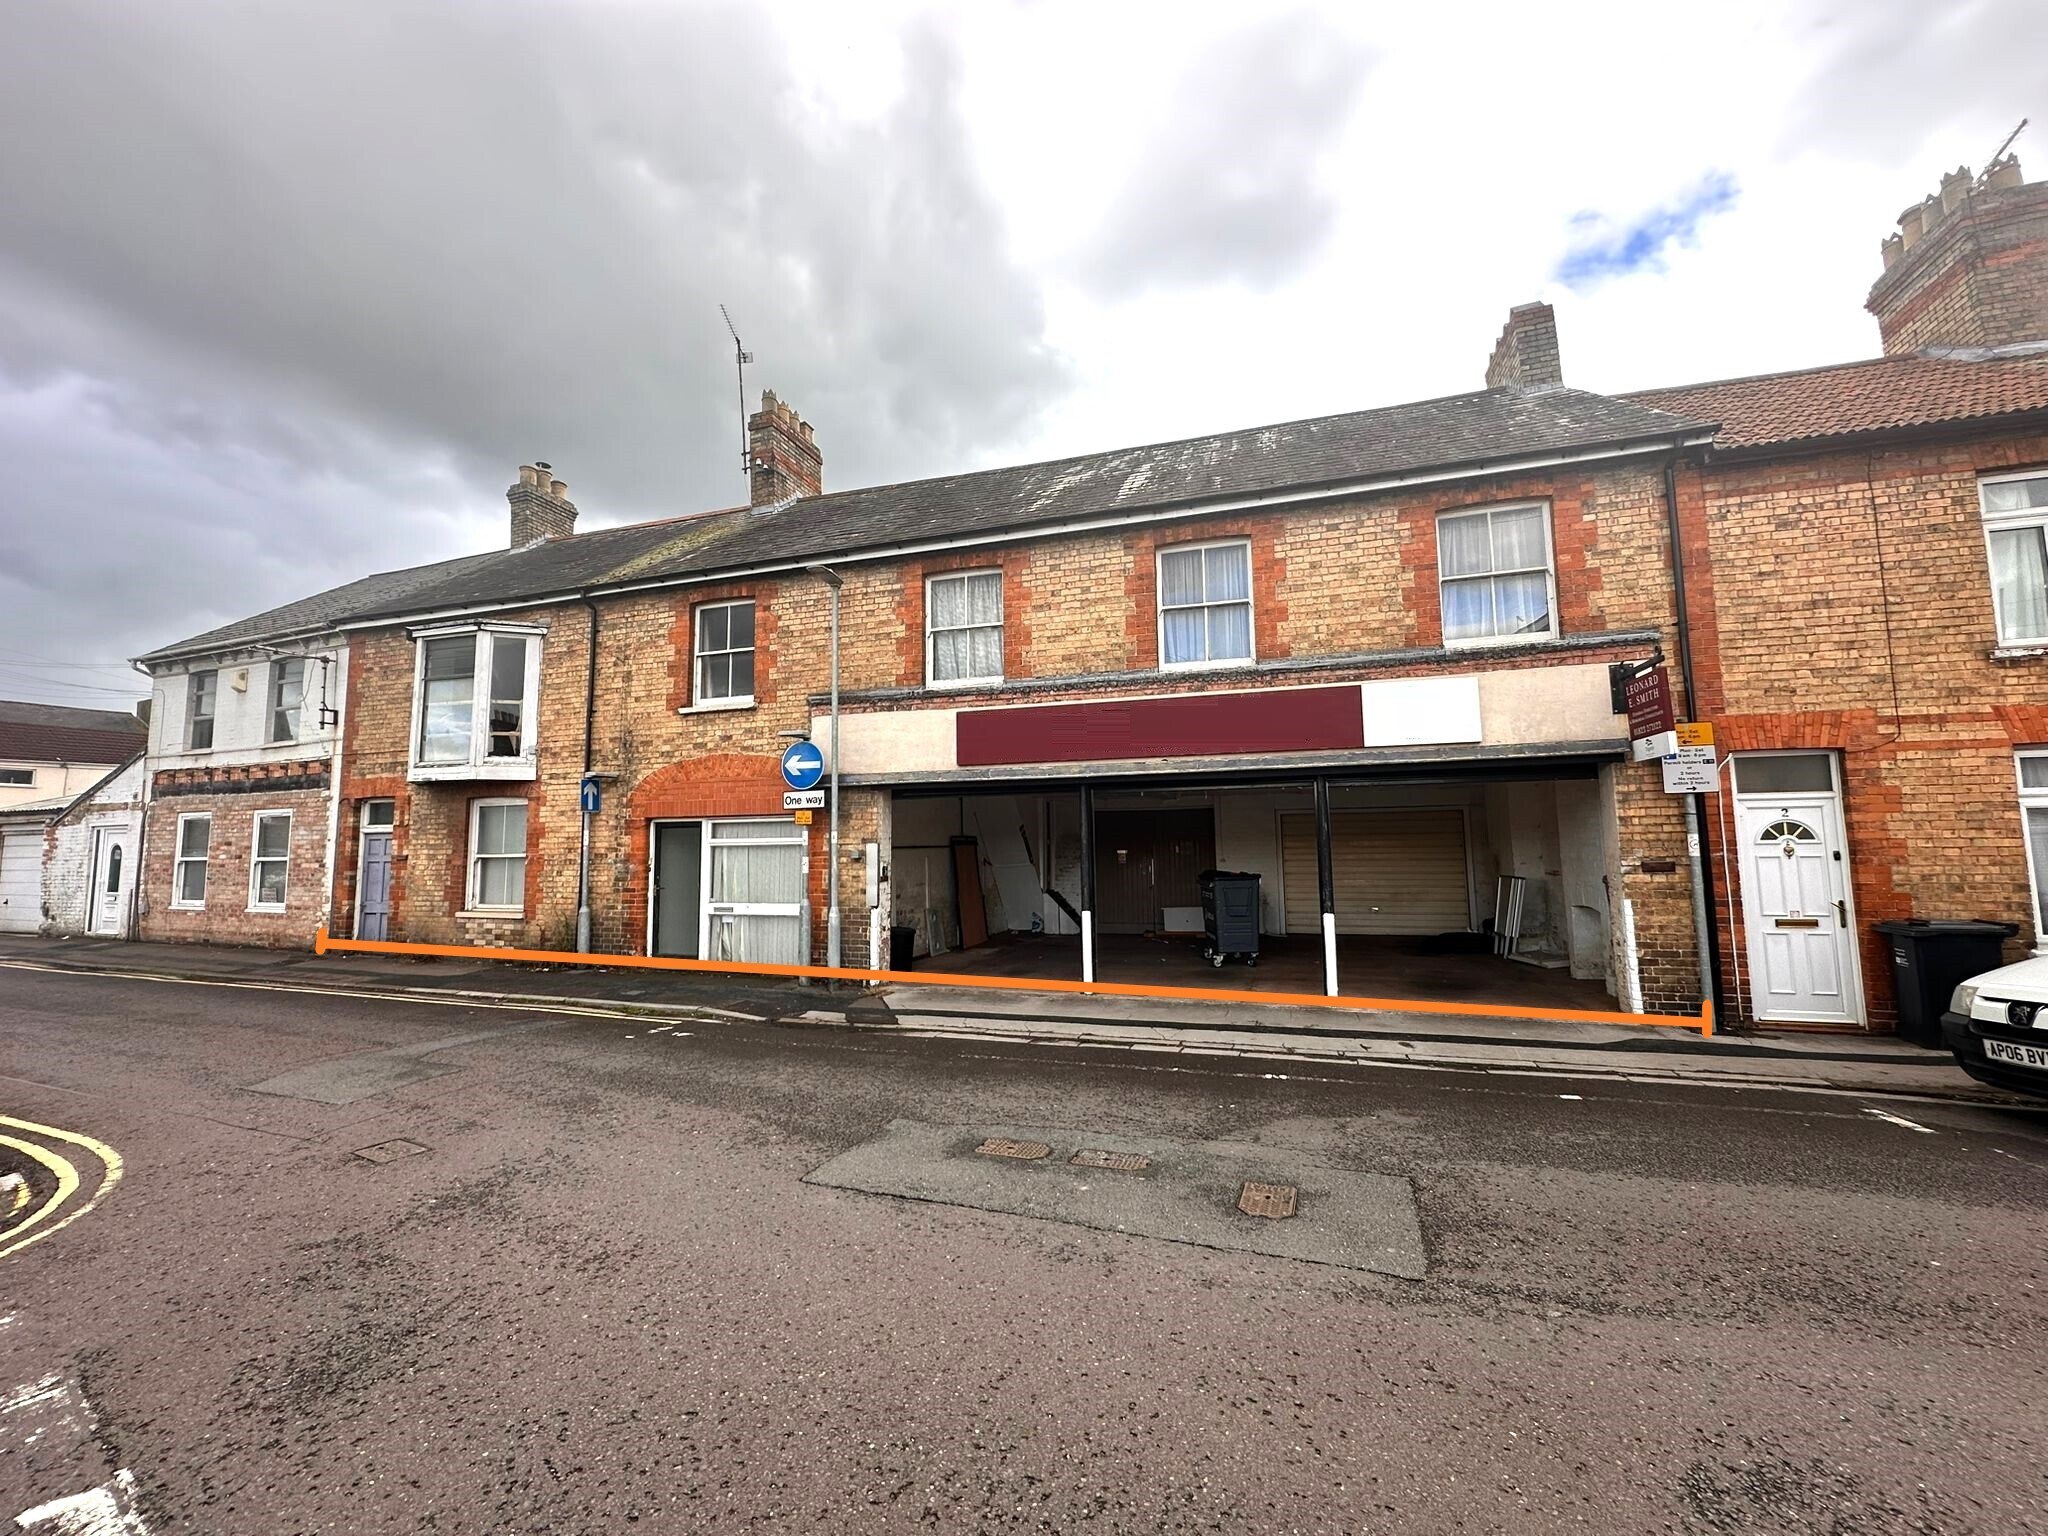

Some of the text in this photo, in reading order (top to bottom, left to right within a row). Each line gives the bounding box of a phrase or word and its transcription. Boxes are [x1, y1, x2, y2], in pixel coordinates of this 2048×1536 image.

[1626, 674, 1659, 697] LEONARD
[1636, 688, 1660, 705] SMITH
[785, 796, 823, 806] One way
[1781, 808, 1789, 817] 2
[1990, 1042, 2048, 1065] AP06 BV
